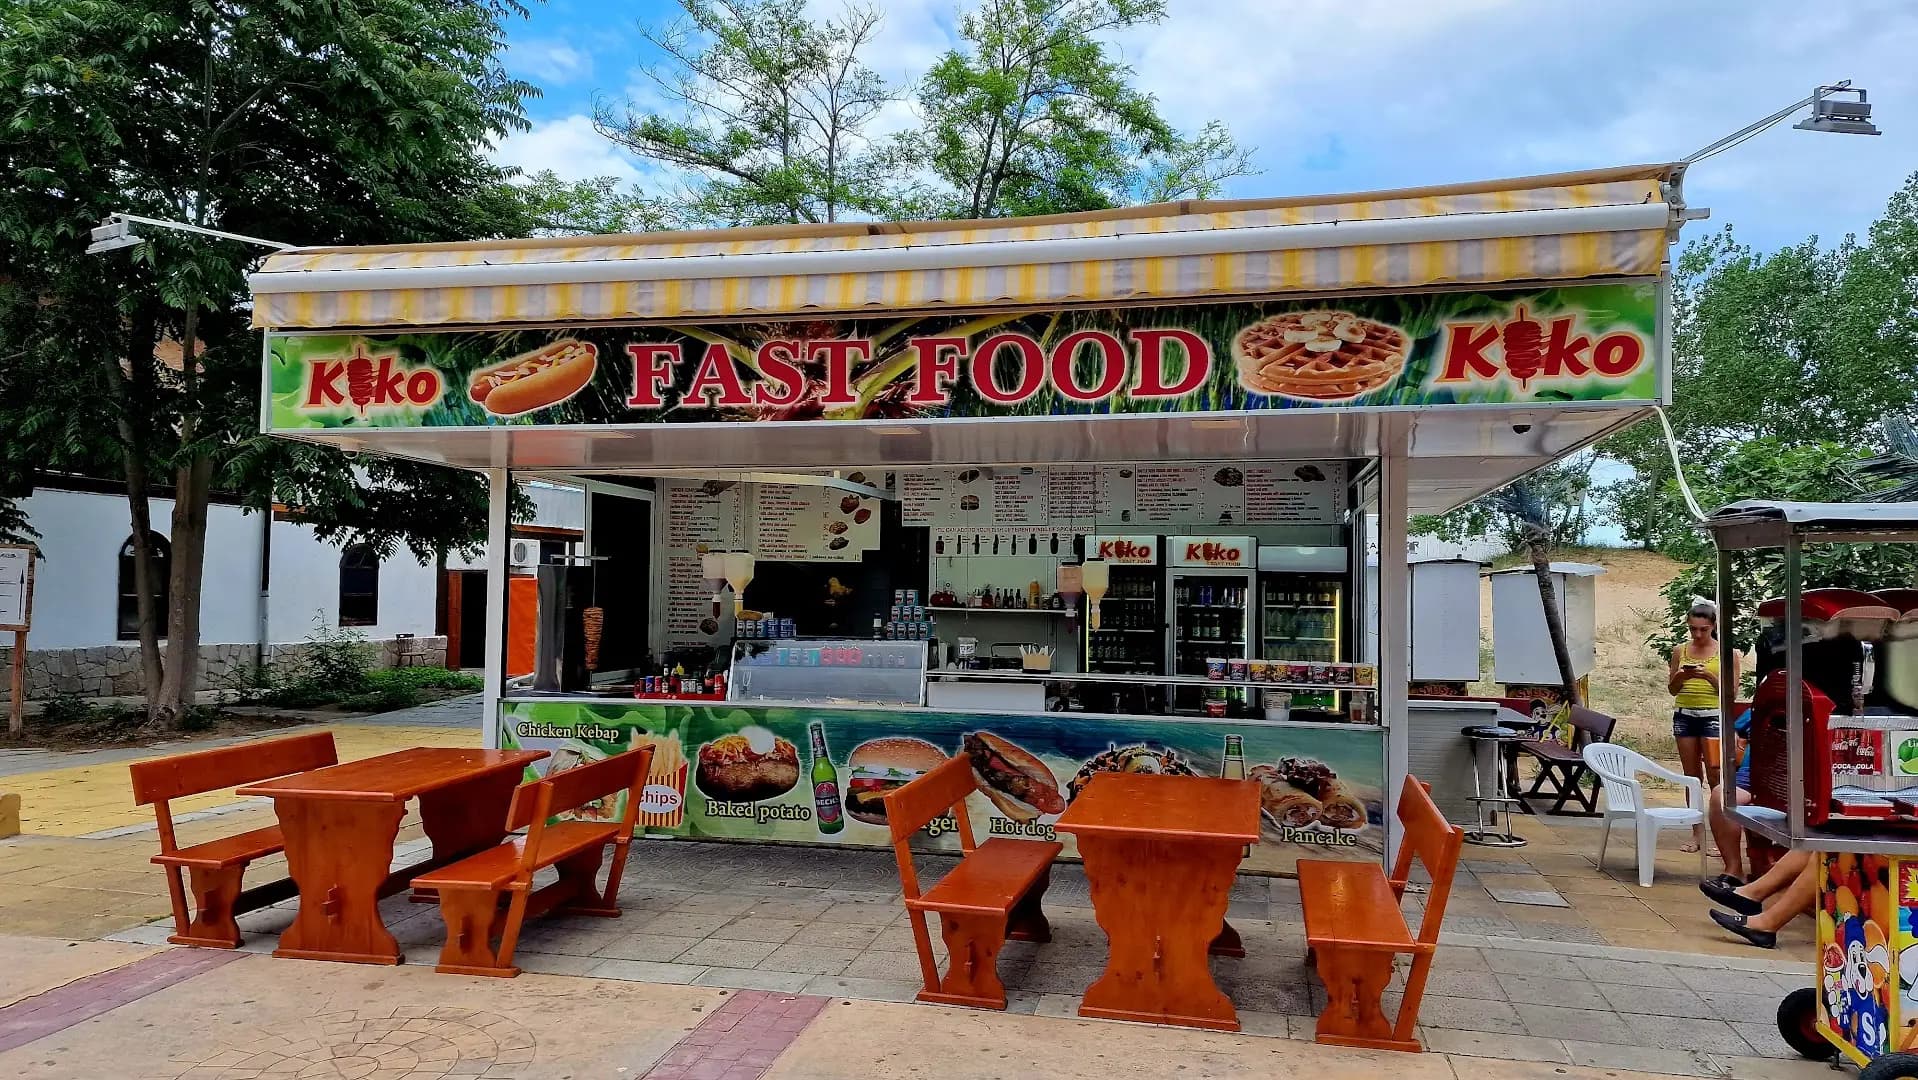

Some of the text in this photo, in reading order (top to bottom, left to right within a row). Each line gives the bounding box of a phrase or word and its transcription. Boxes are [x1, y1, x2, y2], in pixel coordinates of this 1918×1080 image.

[627, 329, 1210, 407] FAST FOOD
[517, 722, 620, 744] Chicken Kebap
[706, 799, 811, 823] Baked potato
[990, 817, 1056, 841] Hot dog
[1281, 825, 1356, 846] Pancake
